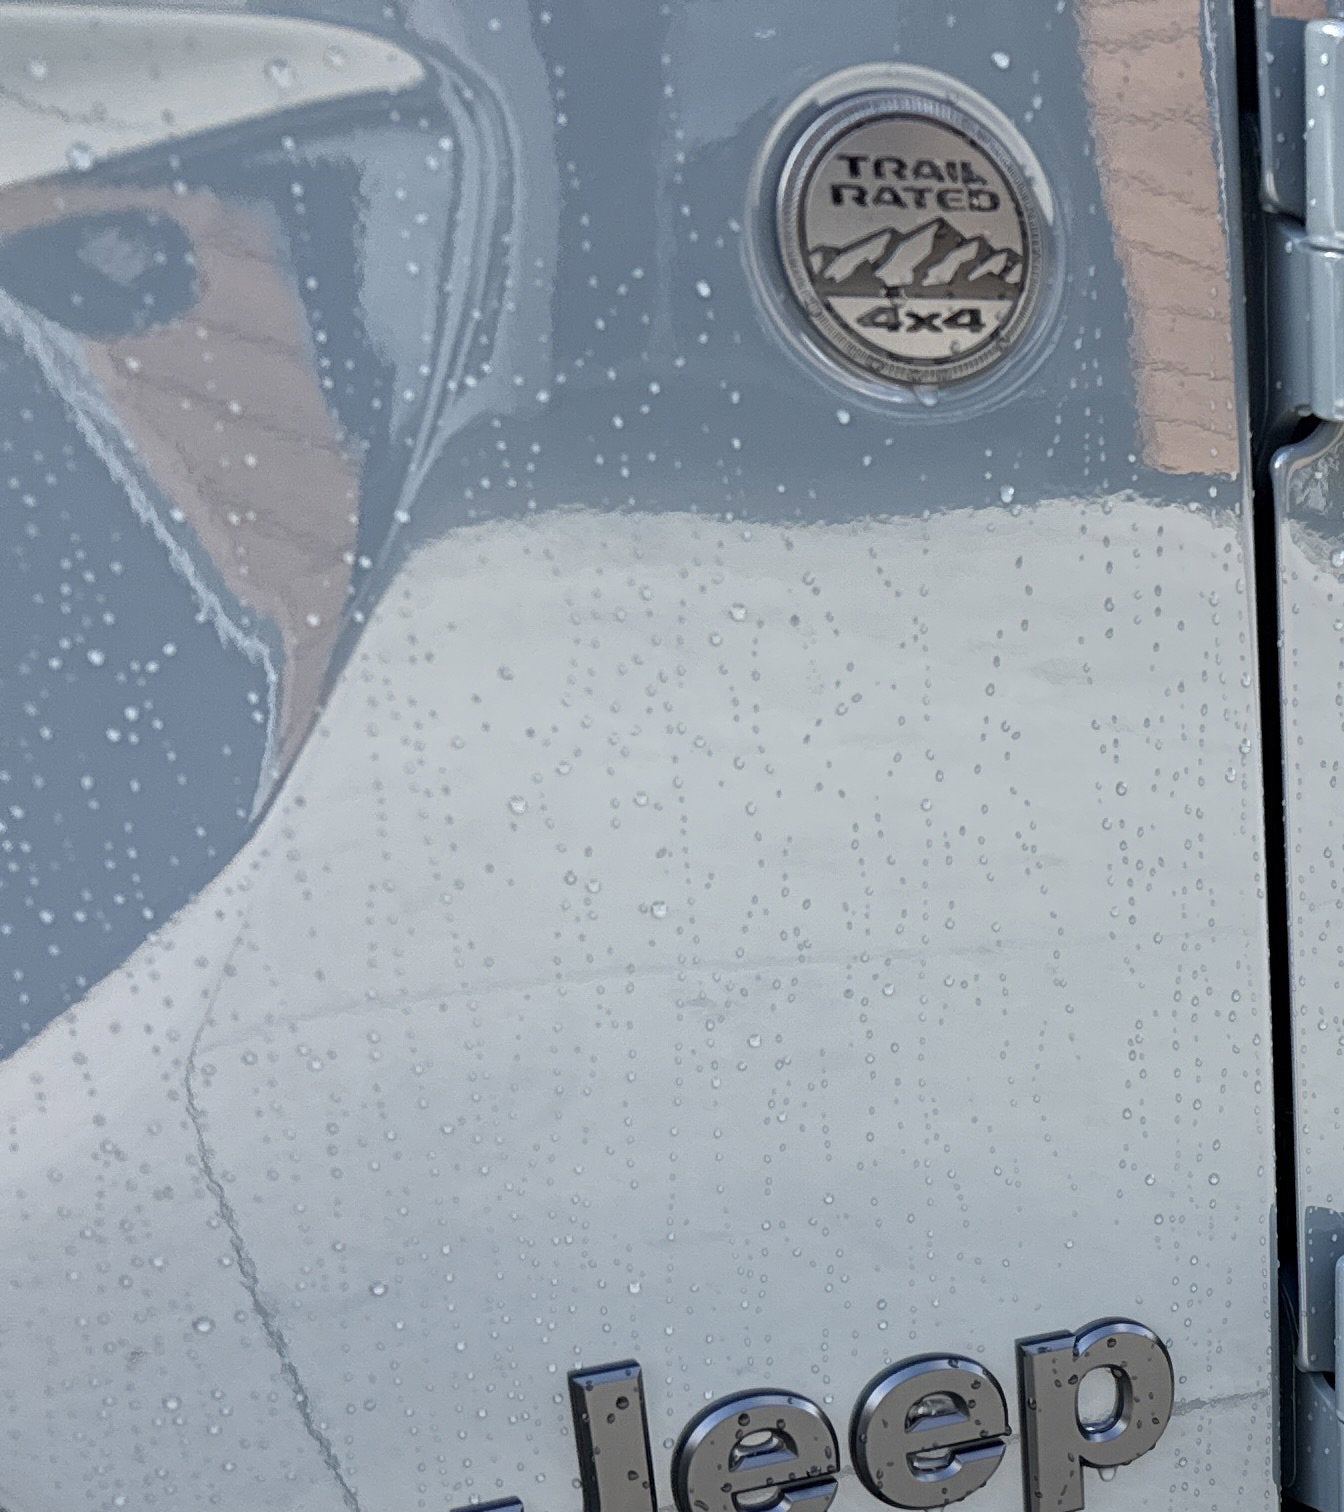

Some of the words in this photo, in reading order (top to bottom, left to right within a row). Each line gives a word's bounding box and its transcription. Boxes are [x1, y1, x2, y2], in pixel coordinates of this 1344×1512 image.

[836, 153, 988, 187] TRAIL
[829, 183, 1001, 213] RATED
[856, 306, 986, 334] 4x4
